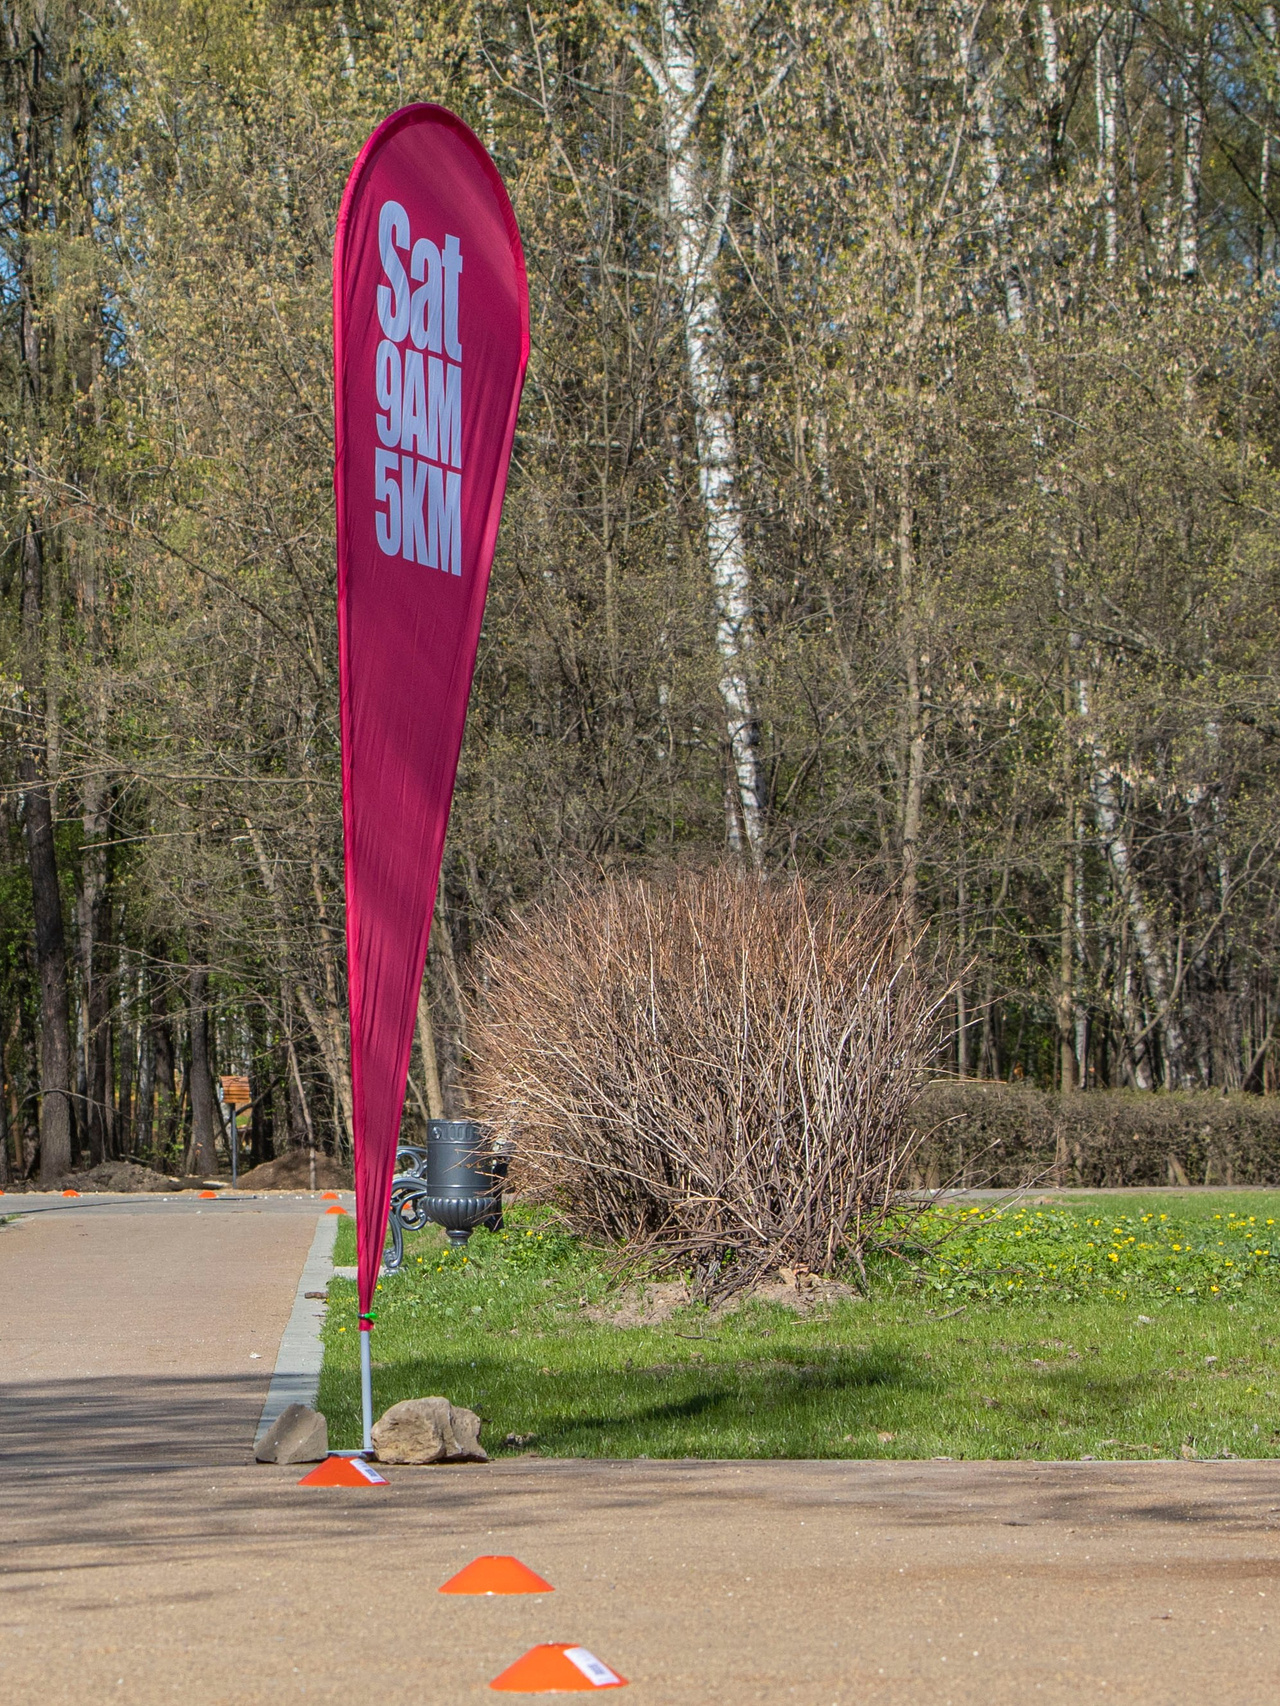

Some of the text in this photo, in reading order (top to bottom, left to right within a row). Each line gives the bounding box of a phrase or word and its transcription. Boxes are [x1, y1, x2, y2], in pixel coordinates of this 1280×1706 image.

[376, 200, 463, 363] Sat
[375, 339, 462, 469] 9AM
[374, 447, 462, 577] 5KM
